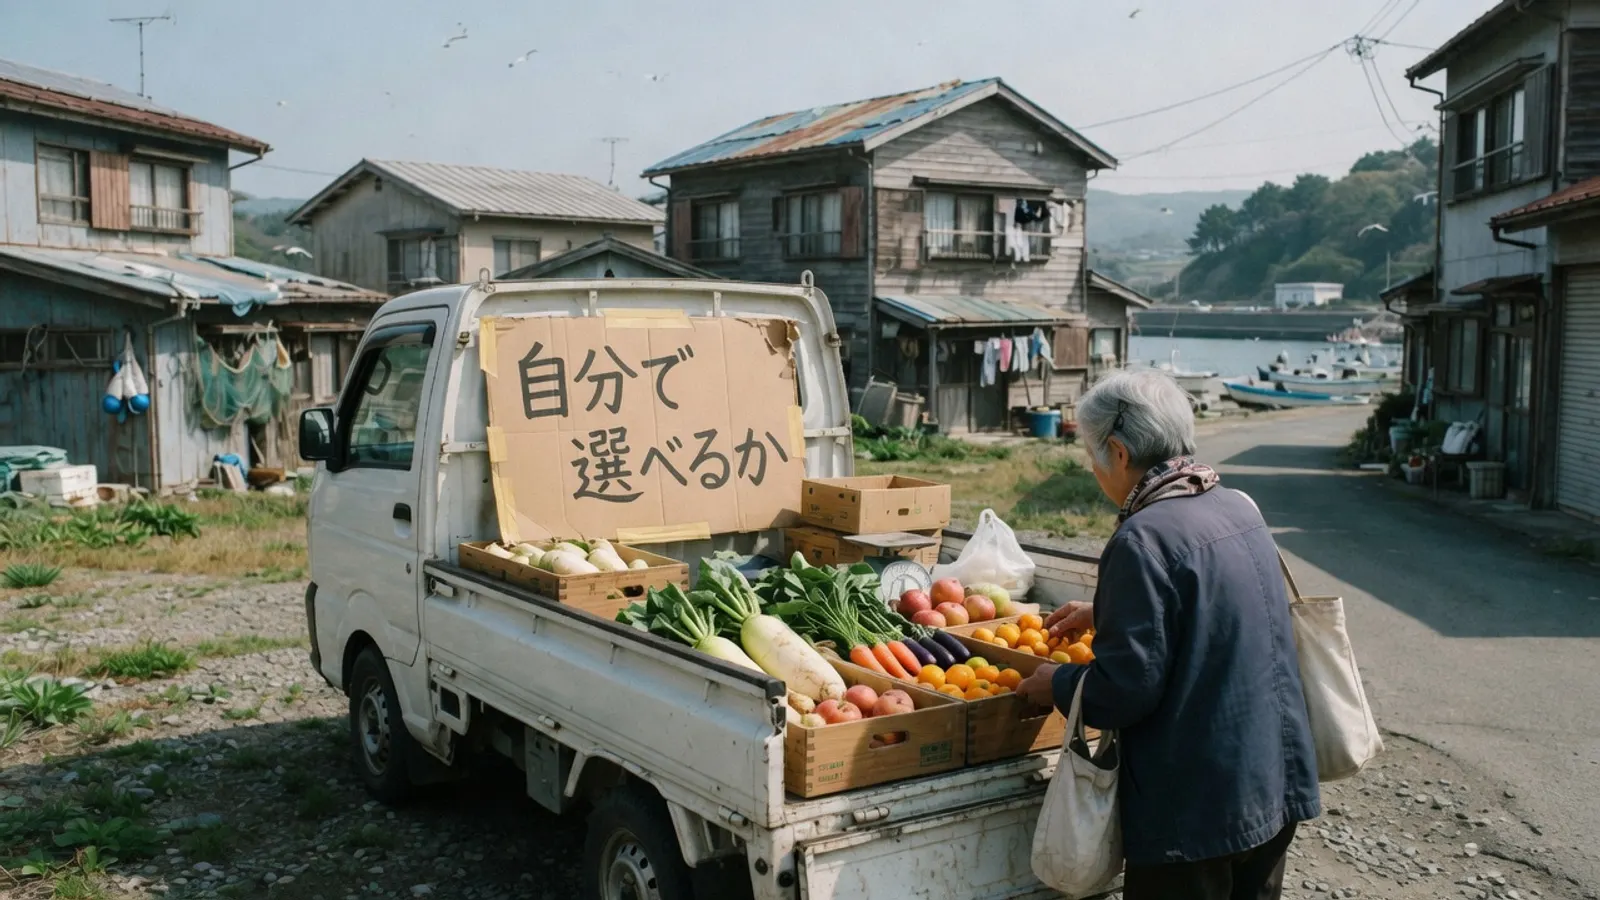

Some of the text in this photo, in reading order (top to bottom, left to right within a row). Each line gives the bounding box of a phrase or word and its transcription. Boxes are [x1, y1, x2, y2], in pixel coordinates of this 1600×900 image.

[518, 341, 694, 420] 自分で
[571, 426, 788, 503] 選べるか
